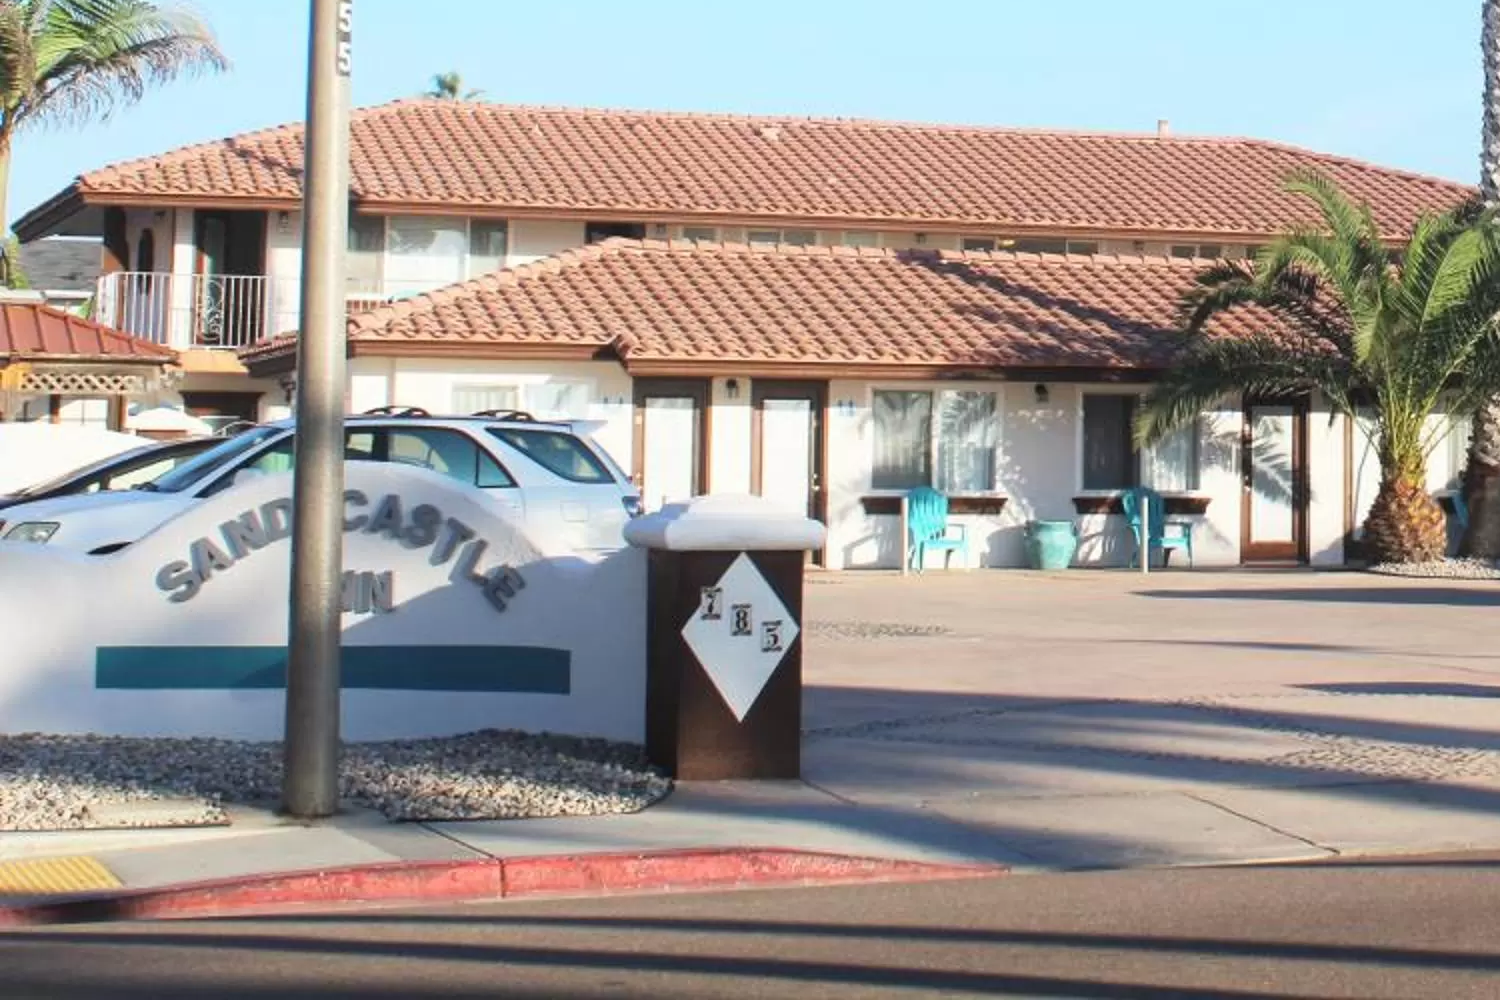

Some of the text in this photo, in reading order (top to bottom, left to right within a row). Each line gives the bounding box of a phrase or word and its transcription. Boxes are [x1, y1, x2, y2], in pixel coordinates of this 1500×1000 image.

[155, 489, 527, 614] SAND CASTLE
[699, 586, 784, 653] 785
